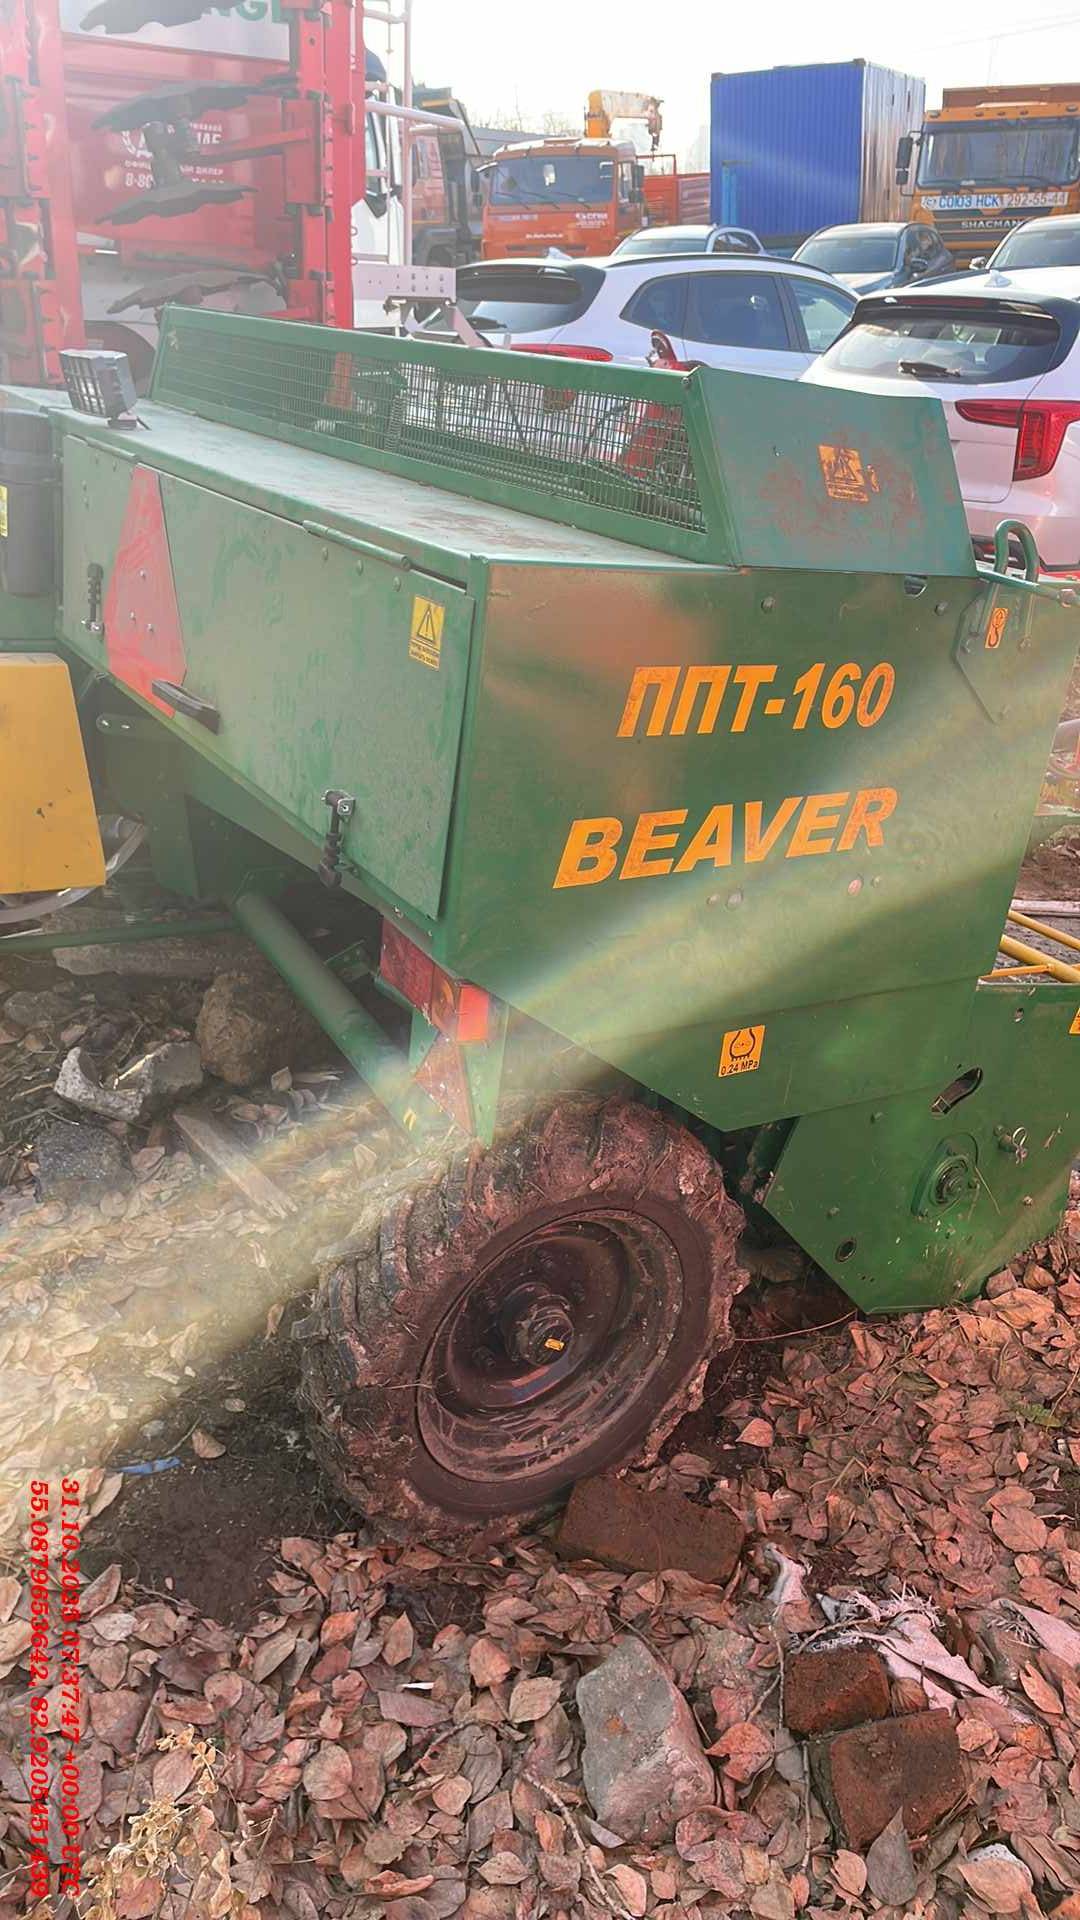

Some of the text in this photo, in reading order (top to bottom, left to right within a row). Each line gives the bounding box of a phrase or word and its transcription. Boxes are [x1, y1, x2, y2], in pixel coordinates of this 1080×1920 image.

[976, 193, 999, 207] НСК
[961, 220, 1021, 229] SHACMAN
[616, 662, 896, 737] ППТ-160
[552, 787, 898, 889] BEAVER
[741, 1060, 758, 1070] MPa
